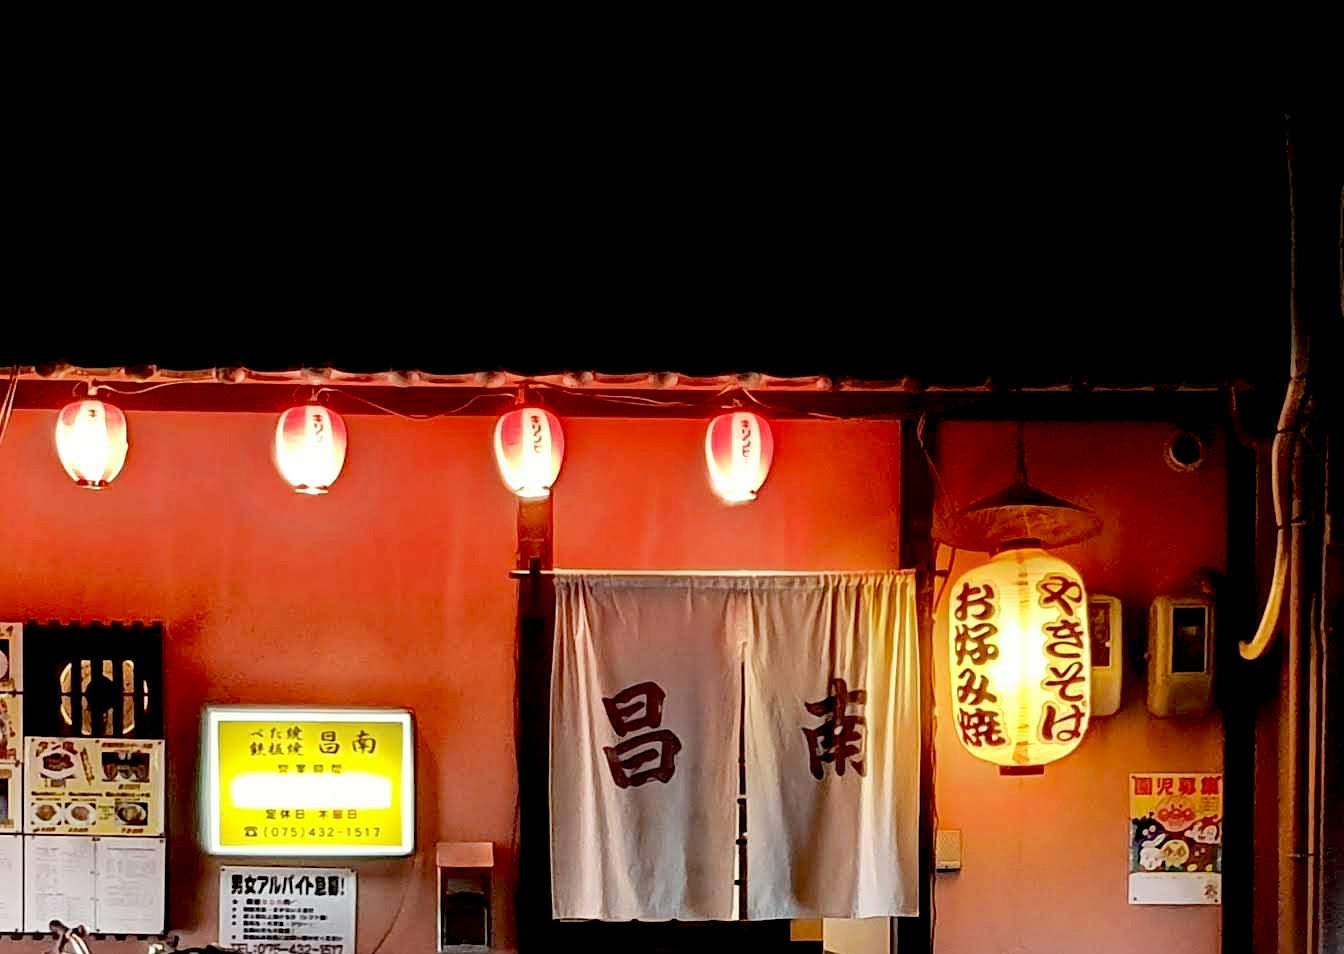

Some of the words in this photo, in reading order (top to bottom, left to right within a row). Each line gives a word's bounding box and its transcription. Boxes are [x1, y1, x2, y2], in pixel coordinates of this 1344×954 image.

[955, 582, 1007, 747] お好み焼
[319, 729, 377, 755] 昌南
[602, 681, 683, 789] 昌
[802, 678, 869, 780] 南
